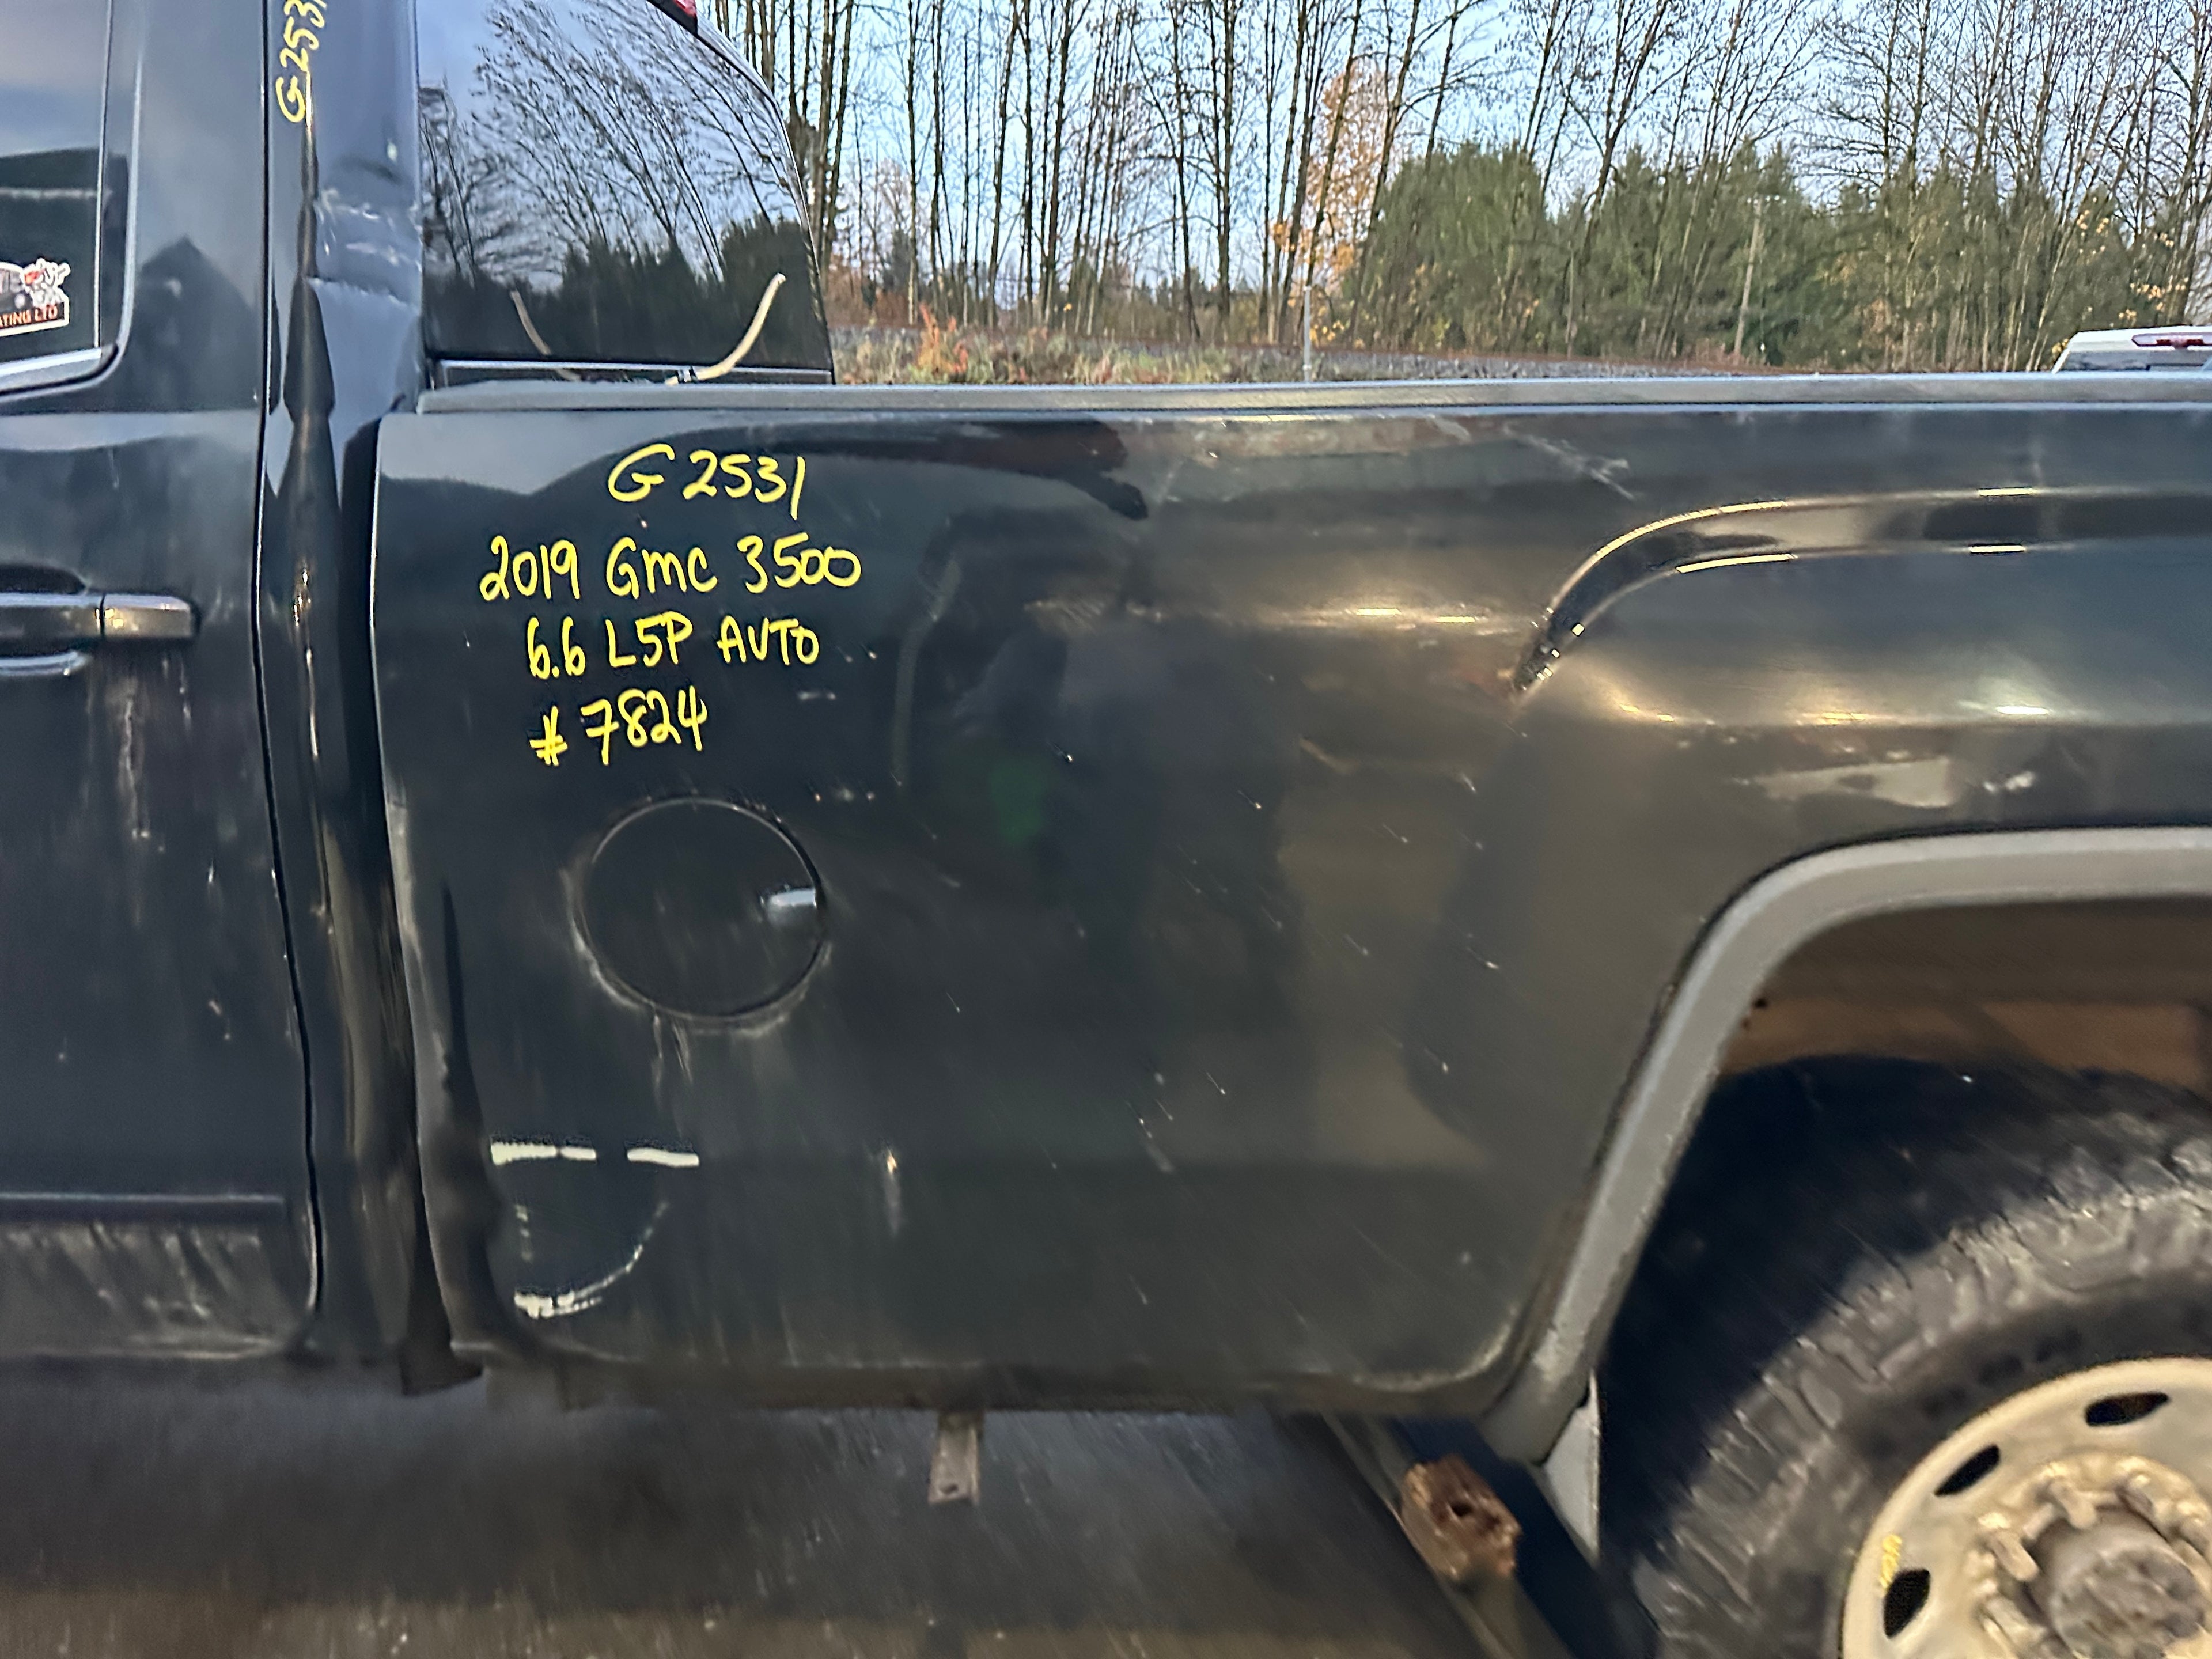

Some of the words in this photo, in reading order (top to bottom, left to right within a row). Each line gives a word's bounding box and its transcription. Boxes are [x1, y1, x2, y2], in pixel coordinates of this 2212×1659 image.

[279, 0, 328, 72] 253
[479, 535, 581, 601] 2019
[736, 531, 862, 594] 3500
[527, 616, 586, 680] 6.6
[604, 610, 694, 668] L5P
[579, 684, 709, 766] 7824
